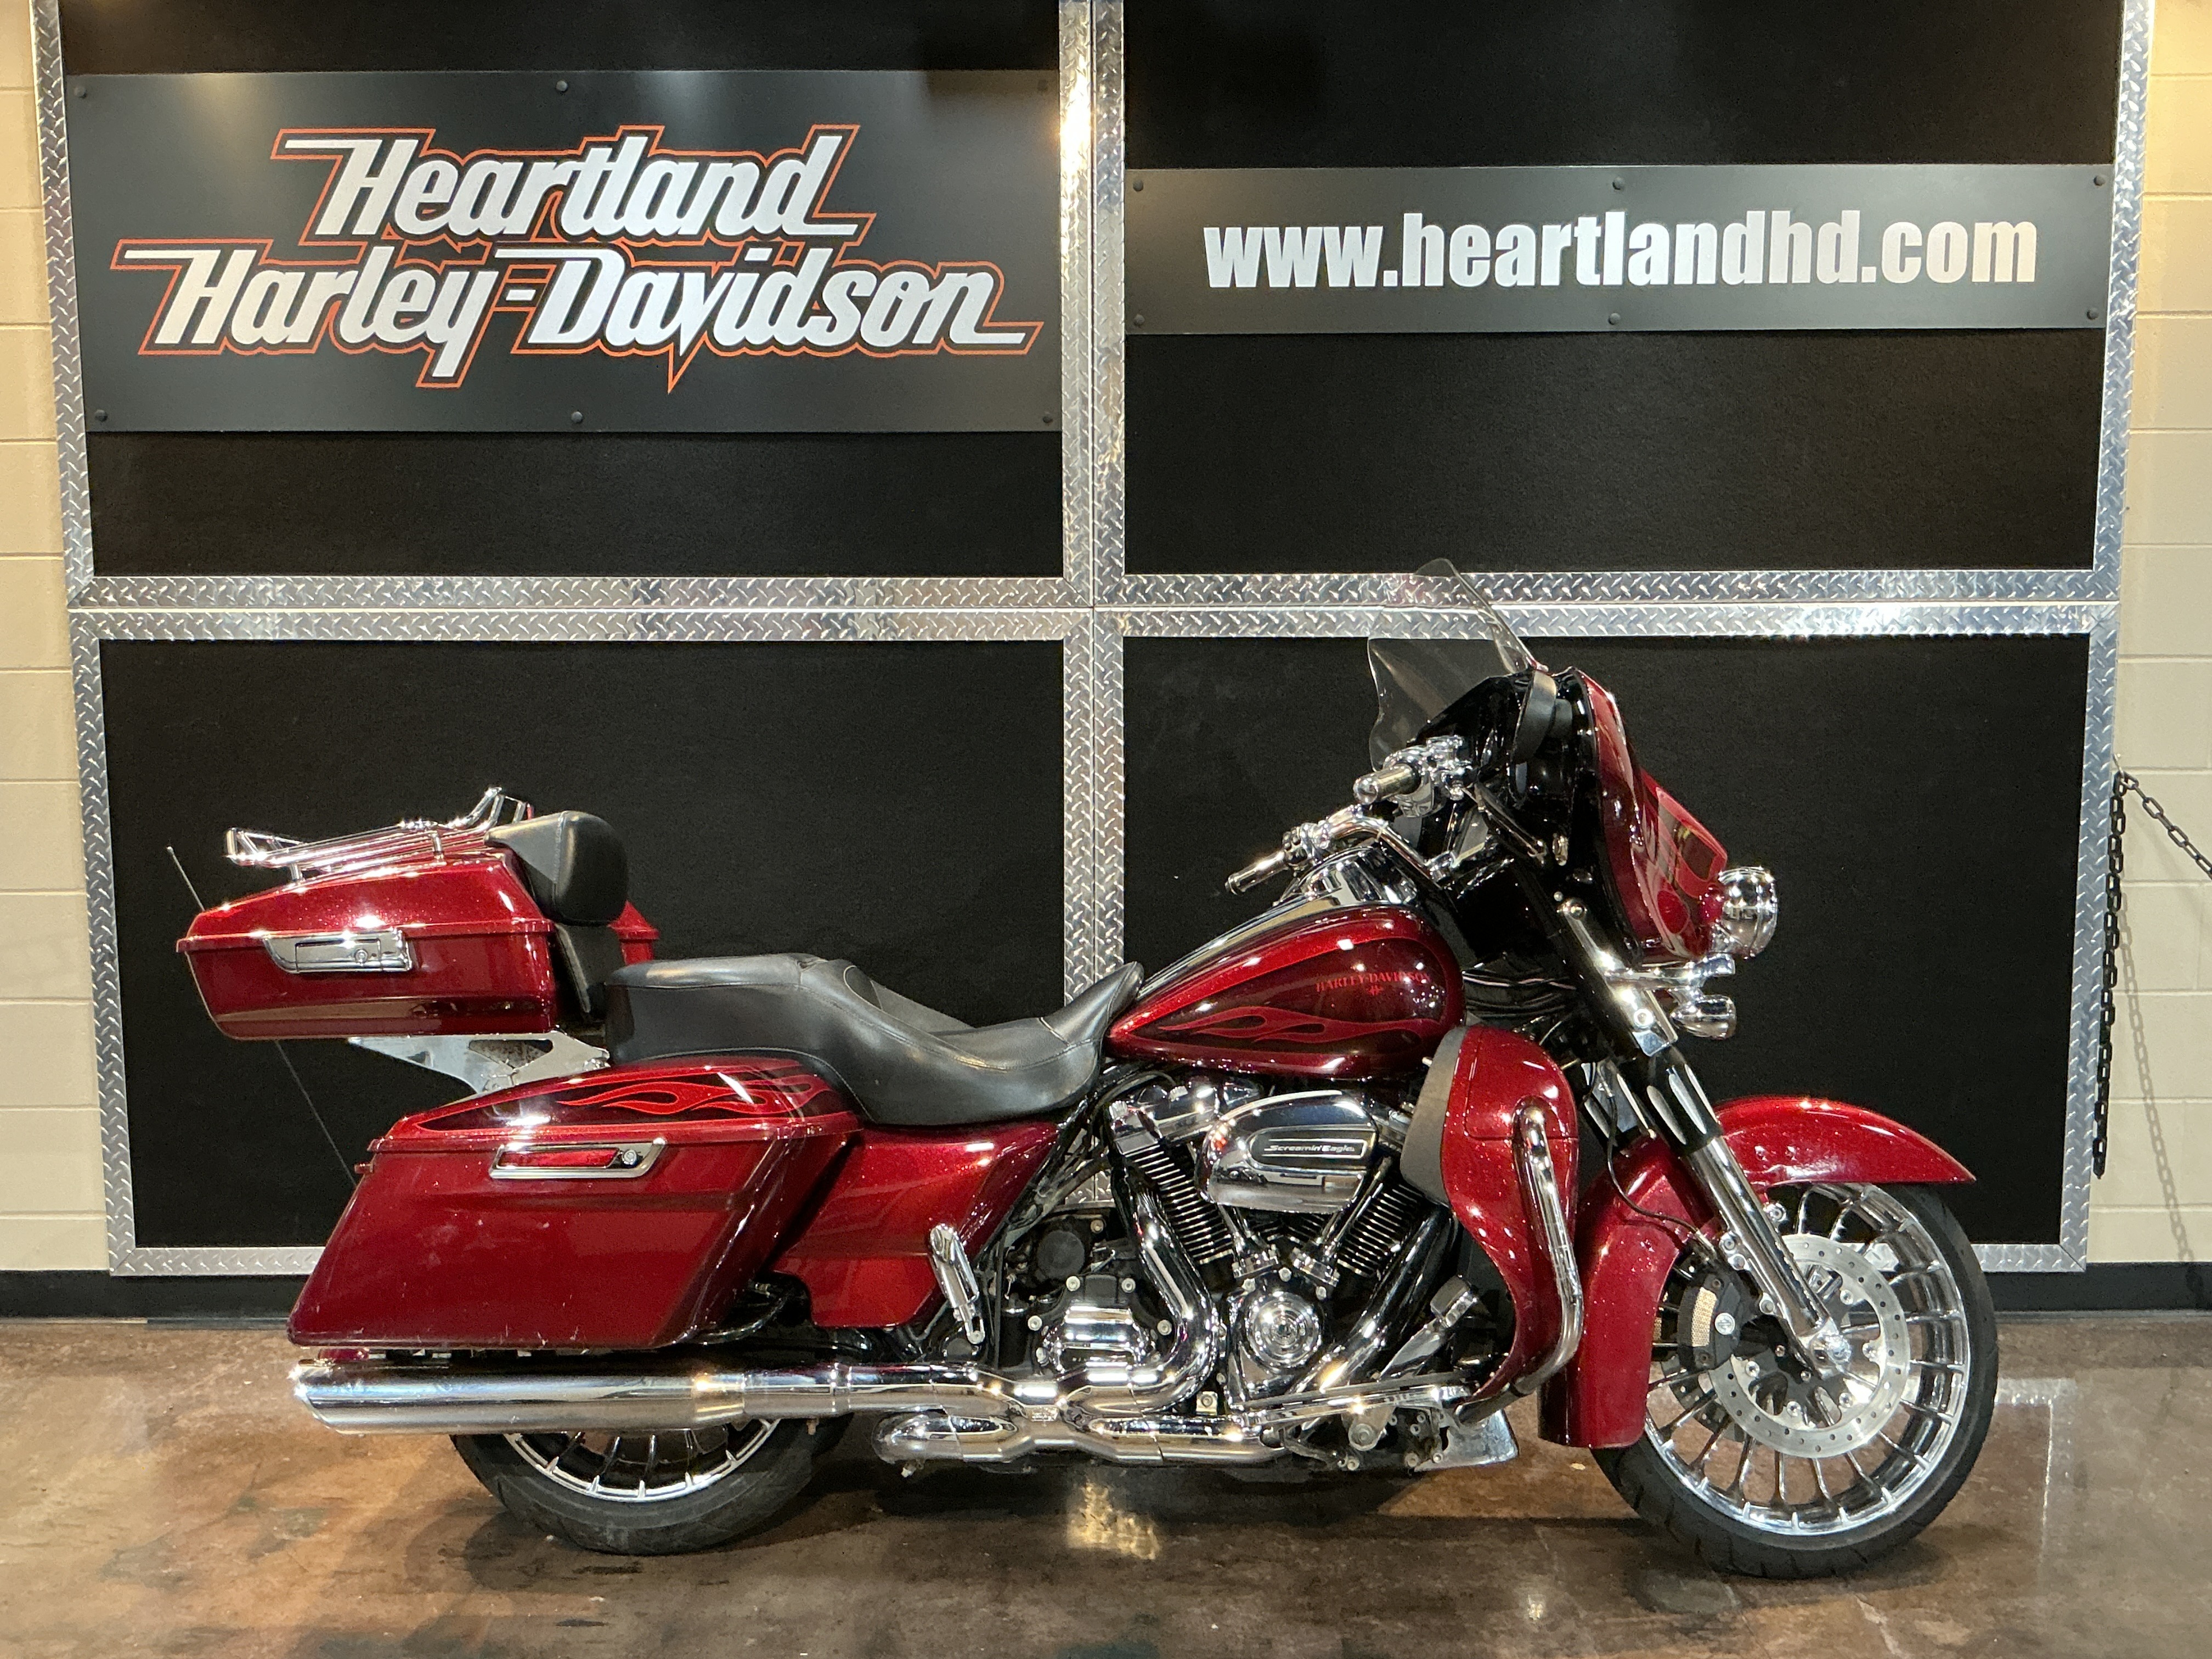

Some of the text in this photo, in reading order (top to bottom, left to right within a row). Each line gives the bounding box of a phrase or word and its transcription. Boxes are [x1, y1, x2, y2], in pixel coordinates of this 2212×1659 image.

[285, 136, 859, 236] Heartland
[1203, 210, 2038, 288] www.heartlandhd.com
[124, 247, 1026, 377] Harley-Davidson
[1322, 1144, 1353, 1153] Eagle
